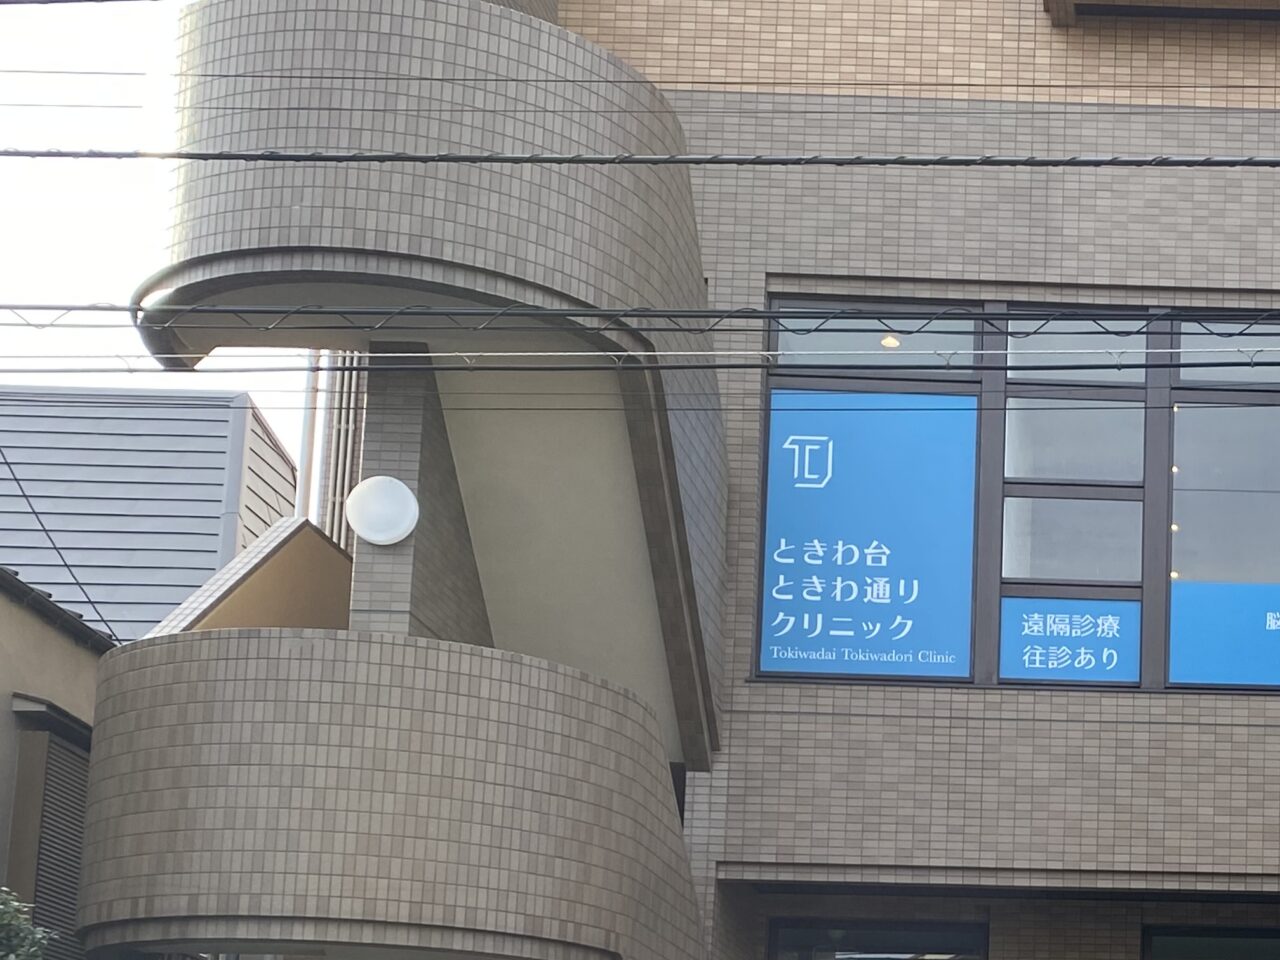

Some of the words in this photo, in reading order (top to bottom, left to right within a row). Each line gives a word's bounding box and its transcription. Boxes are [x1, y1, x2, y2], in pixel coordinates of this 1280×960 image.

[773, 538, 891, 567] ときわ台
[771, 575, 919, 605] ときわ通り
[771, 612, 913, 641] クリニック
[1021, 613, 1121, 638] 遠隔診療
[769, 646, 837, 661] Tokiwadai
[841, 648, 914, 663] Tokiwadori
[917, 650, 957, 664] Clinic
[1022, 645, 1119, 670] 往診あり
